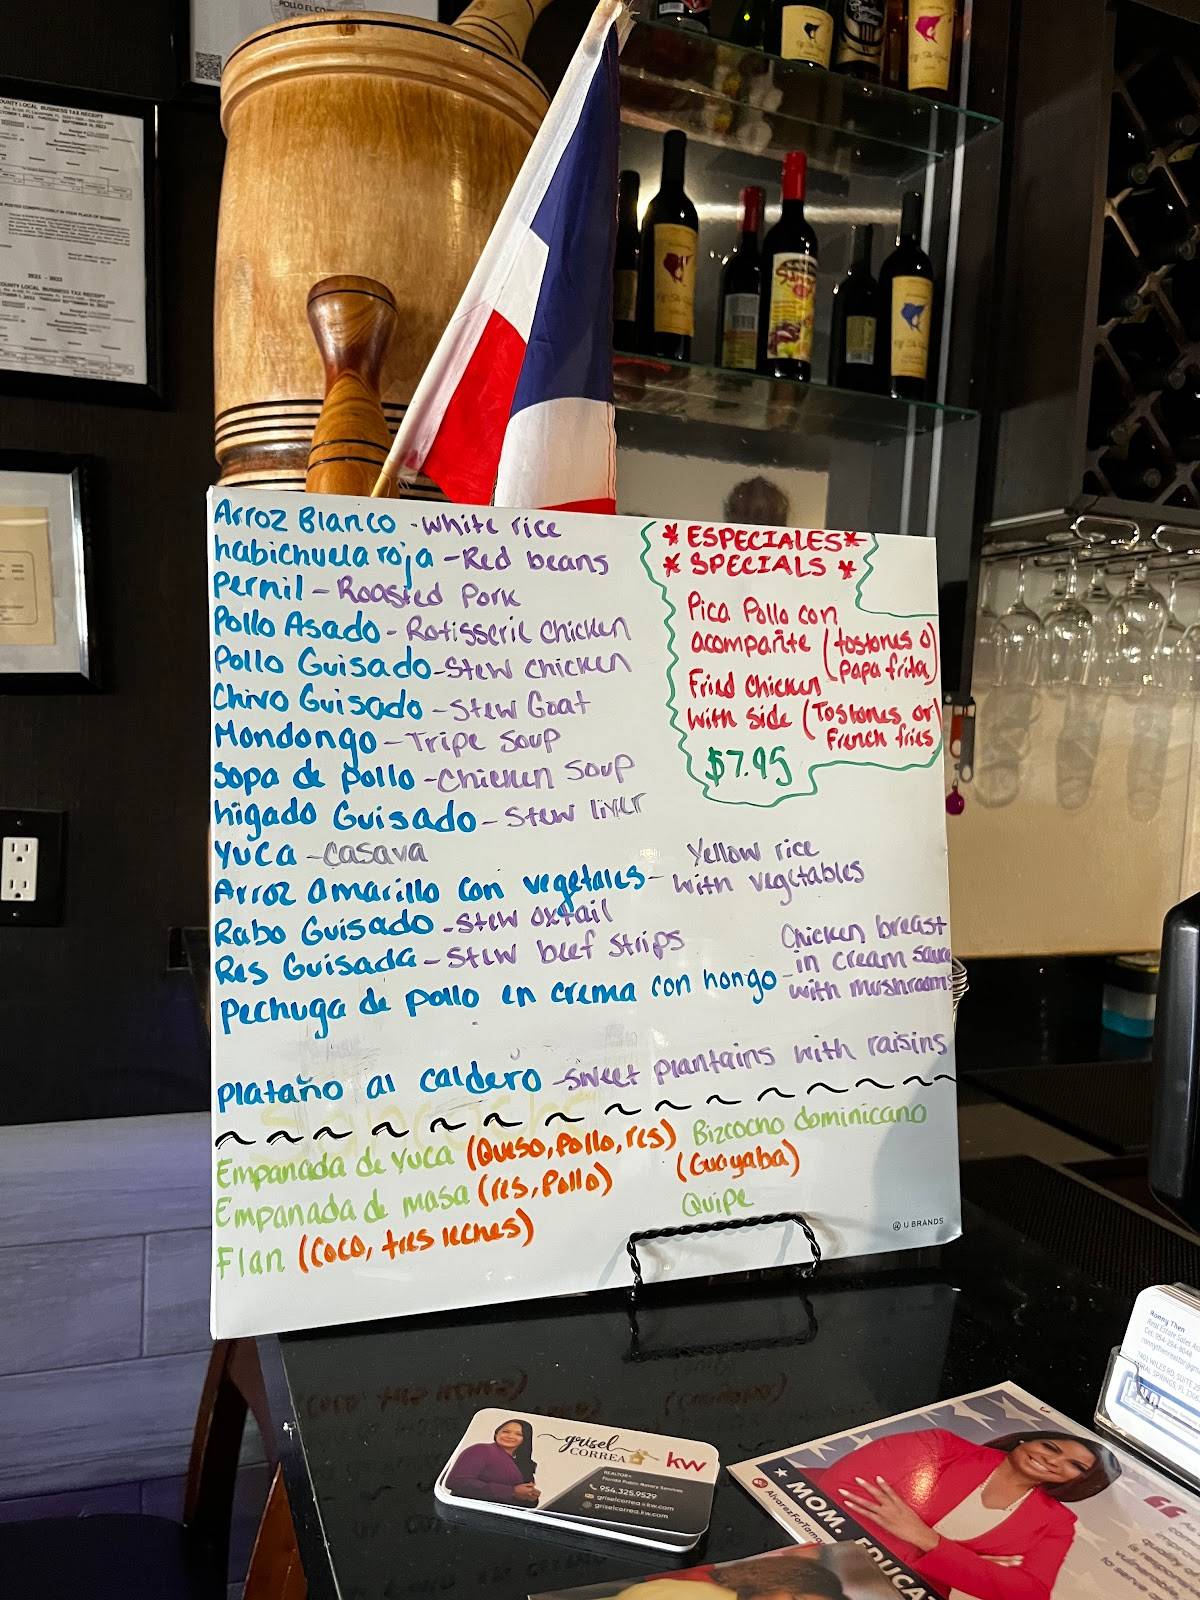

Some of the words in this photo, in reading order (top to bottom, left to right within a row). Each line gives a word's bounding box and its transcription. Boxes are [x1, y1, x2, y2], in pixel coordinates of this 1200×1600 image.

[279, 1, 303, 10] POLLO
[214, 499, 288, 529] Arroz
[298, 508, 396, 535] Blanco
[511, 517, 562, 538] rice
[214, 535, 370, 567] habichuela
[377, 541, 434, 591] roja
[527, 542, 608, 576] beans
[337, 575, 443, 607] Roasted
[687, 591, 730, 624] Pica
[743, 596, 789, 625] Pollo
[798, 605, 838, 625] con
[213, 606, 275, 638] Pollo
[285, 610, 381, 645] Asado
[213, 645, 284, 675] Pollo
[298, 645, 431, 681] Guisado
[212, 684, 289, 715] Chivo
[299, 683, 424, 719] Guisado
[214, 720, 377, 768] Mondongo
[333, 800, 477, 833] Guisado
[687, 837, 761, 867] Yellow
[775, 839, 820, 861] rice
[214, 878, 296, 907] Arroz
[215, 916, 286, 948] Rabo
[301, 908, 434, 946] Guisado
[875, 914, 947, 940] breast
[216, 955, 268, 987] Res
[703, 967, 777, 1005] hongo
[419, 1060, 542, 1095] caldero
[654, 1043, 776, 1086] plantains
[868, 1031, 948, 1057] raisins
[217, 1151, 346, 1190] Empanada
[217, 1194, 356, 1233] Empanada
[402, 1183, 470, 1218] masa
[903, 1220, 908, 1228] U
[909, 1217, 944, 1227] BRANDS
[218, 1245, 285, 1279] Flan
[571, 1448, 626, 1464] CORREA
[666, 1451, 707, 1472] kw
[599, 1484, 658, 1500] 954.325.9529
[786, 1481, 846, 1534] MOM.
